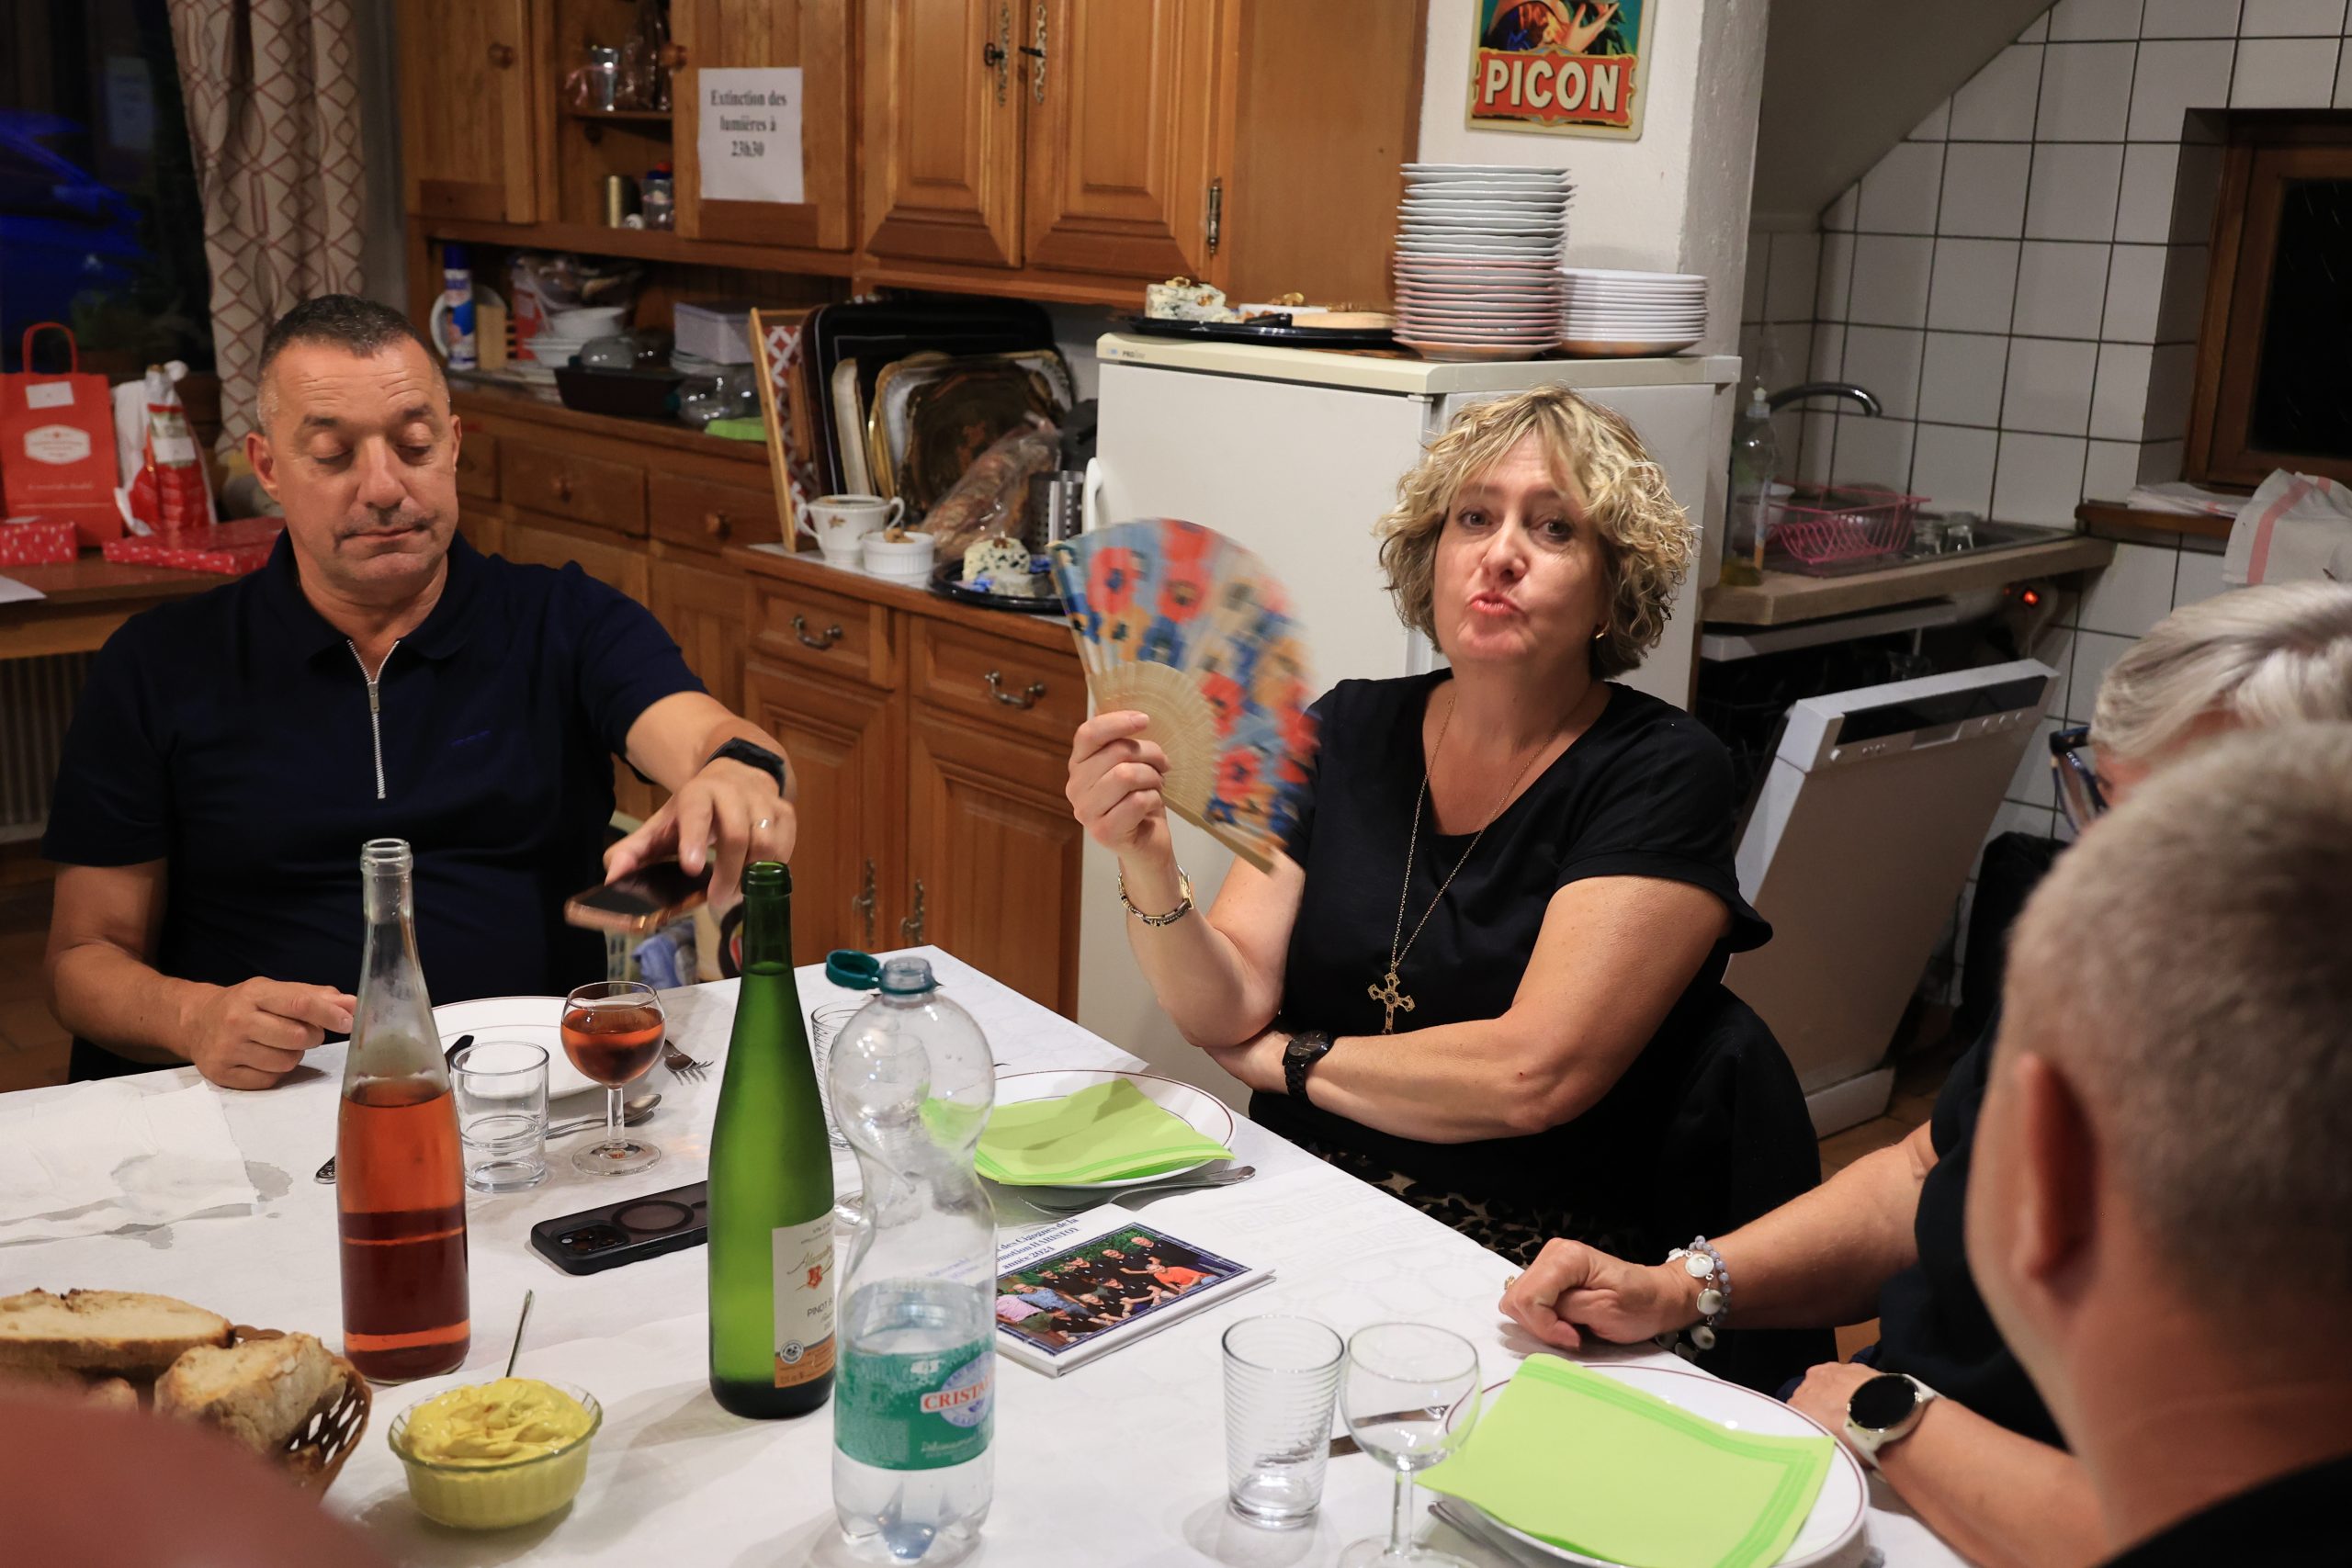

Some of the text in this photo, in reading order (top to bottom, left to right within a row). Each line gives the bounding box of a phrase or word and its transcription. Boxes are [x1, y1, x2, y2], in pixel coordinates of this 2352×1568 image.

[1485, 59, 1619, 112] PICON
[710, 90, 786, 107] Extinction des
[720, 116, 776, 131] lumières à
[731, 141, 764, 157] 23h30
[1001, 1240, 1016, 1250] des
[1015, 1228, 1057, 1243] Cigognes
[1030, 1228, 1080, 1247] HARISTOY
[1001, 1256, 1029, 1269] année
